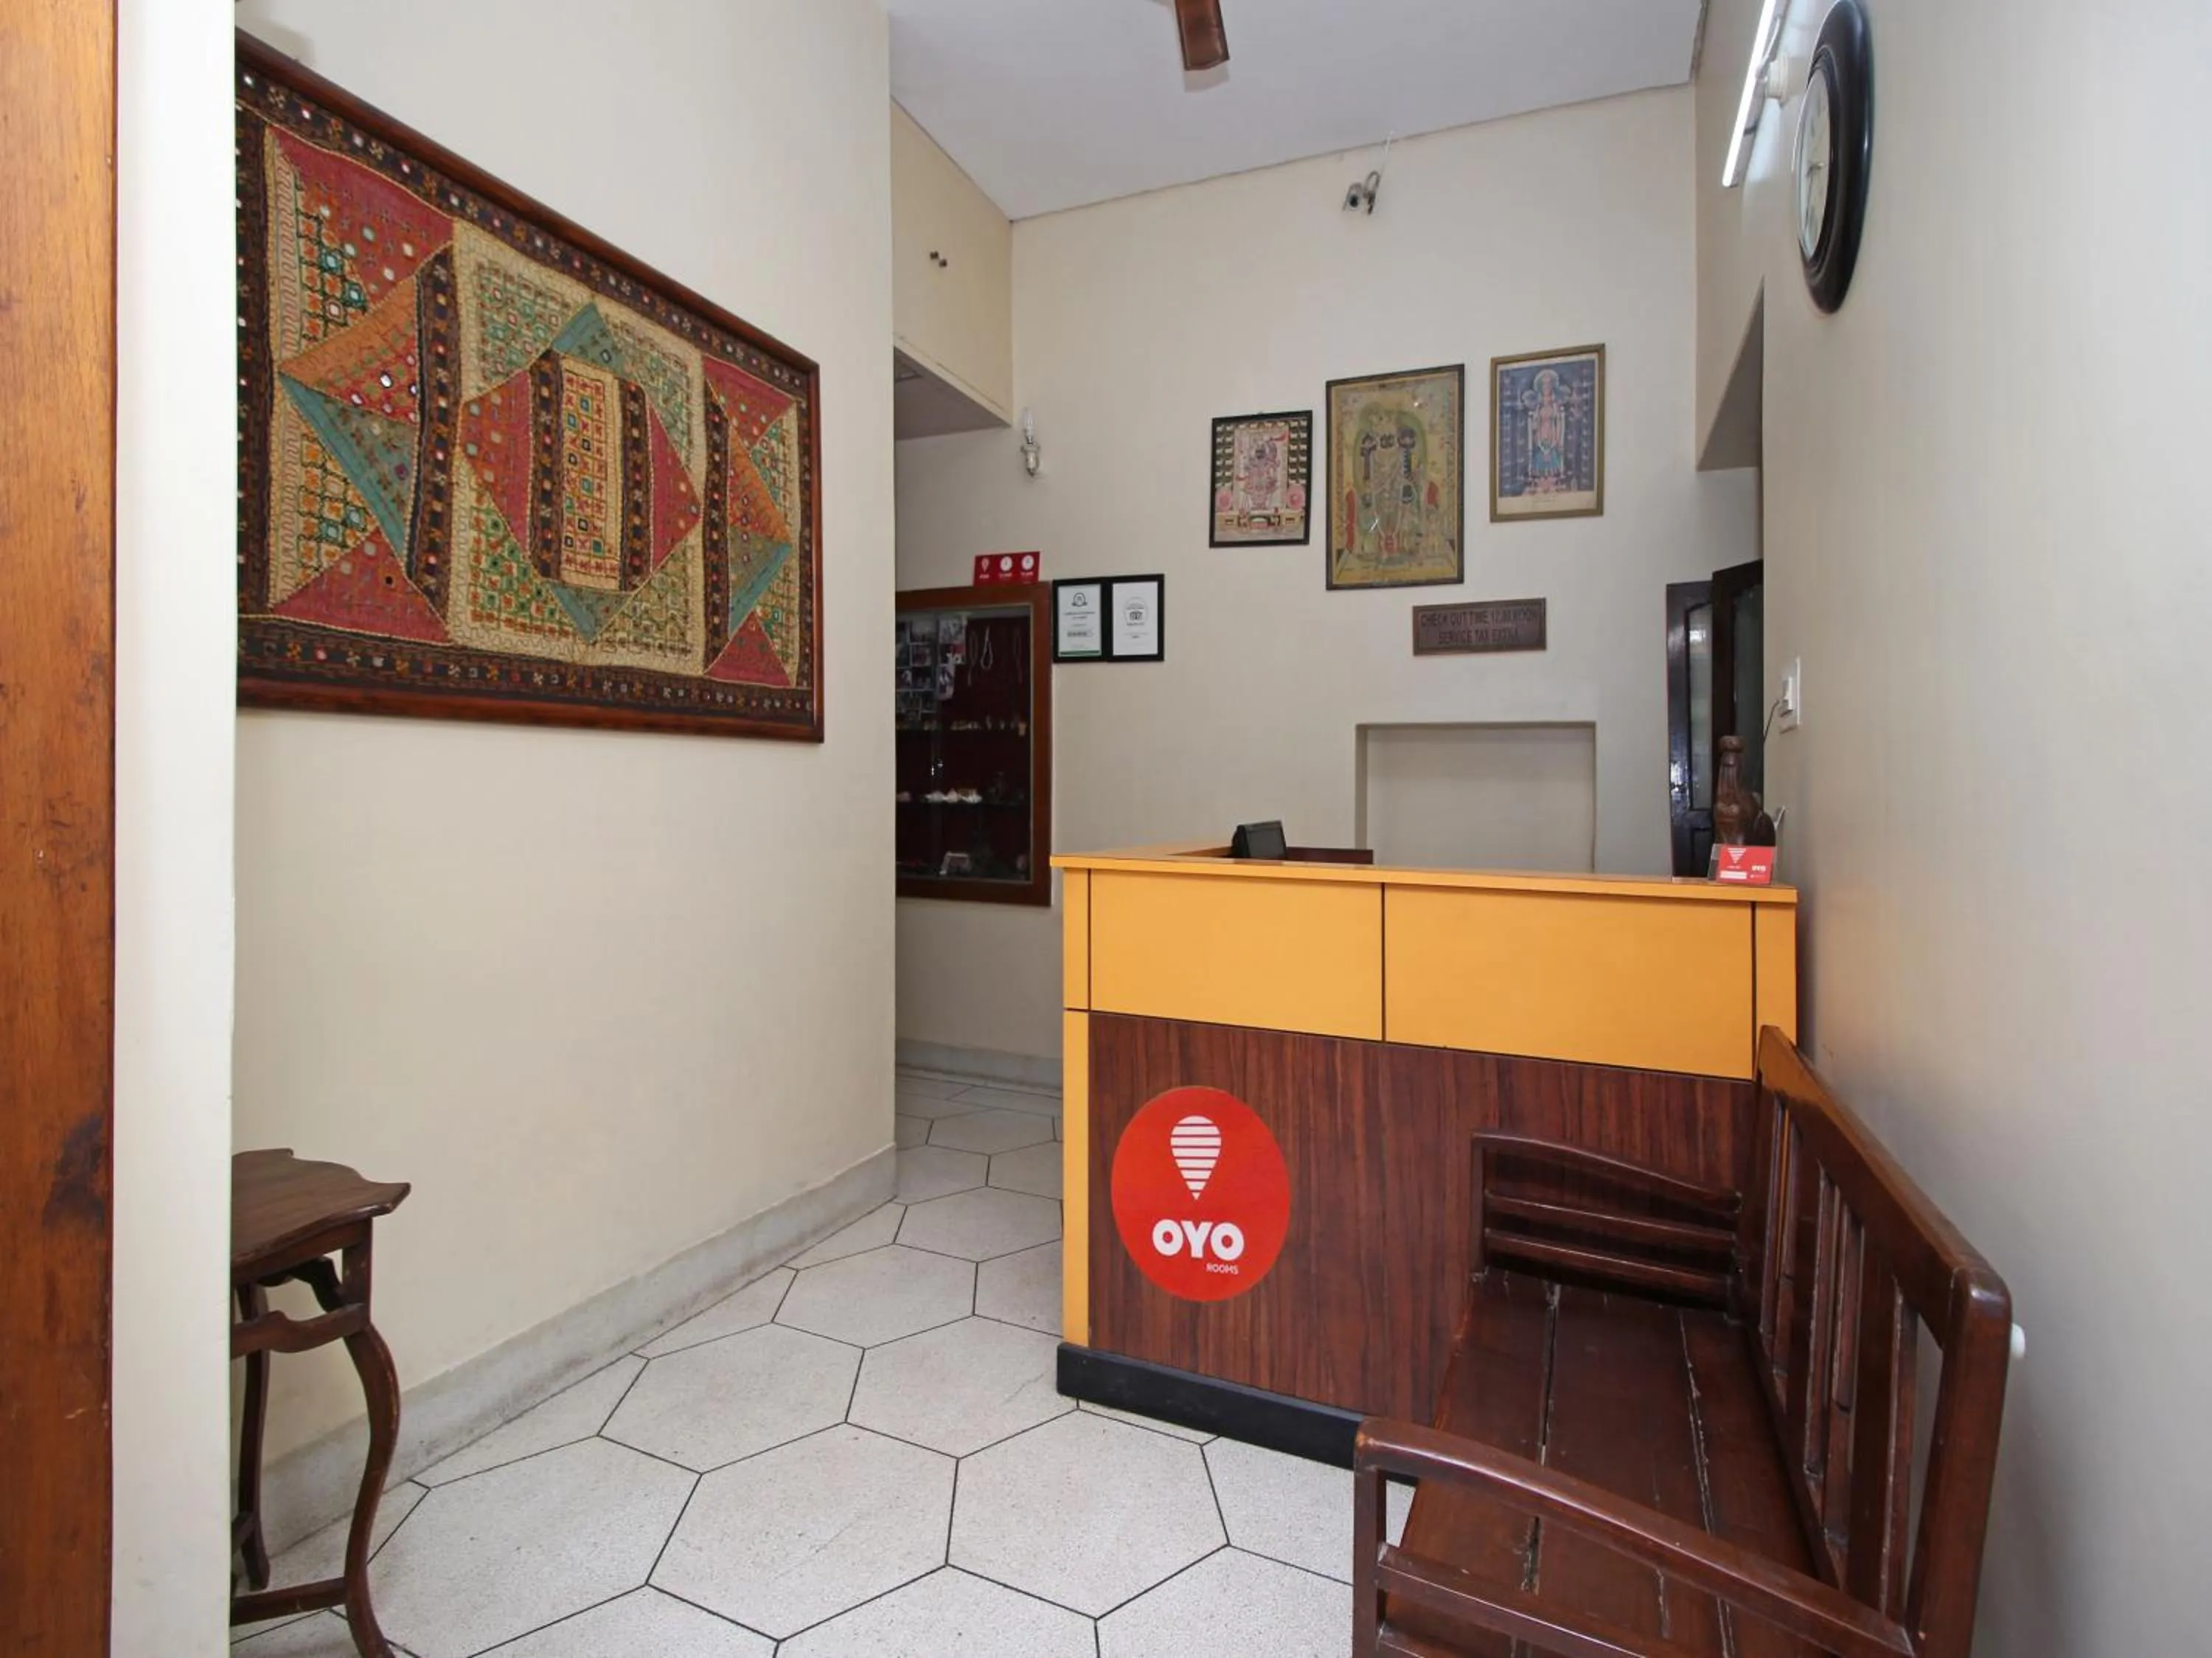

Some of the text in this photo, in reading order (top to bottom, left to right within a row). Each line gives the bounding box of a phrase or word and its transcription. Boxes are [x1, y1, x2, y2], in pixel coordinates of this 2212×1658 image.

[1420, 613, 1447, 627] CHECK
[1450, 611, 1467, 626] OUT
[1152, 1218, 1245, 1261] OYO
[1206, 1262, 1239, 1275] ROOMS
